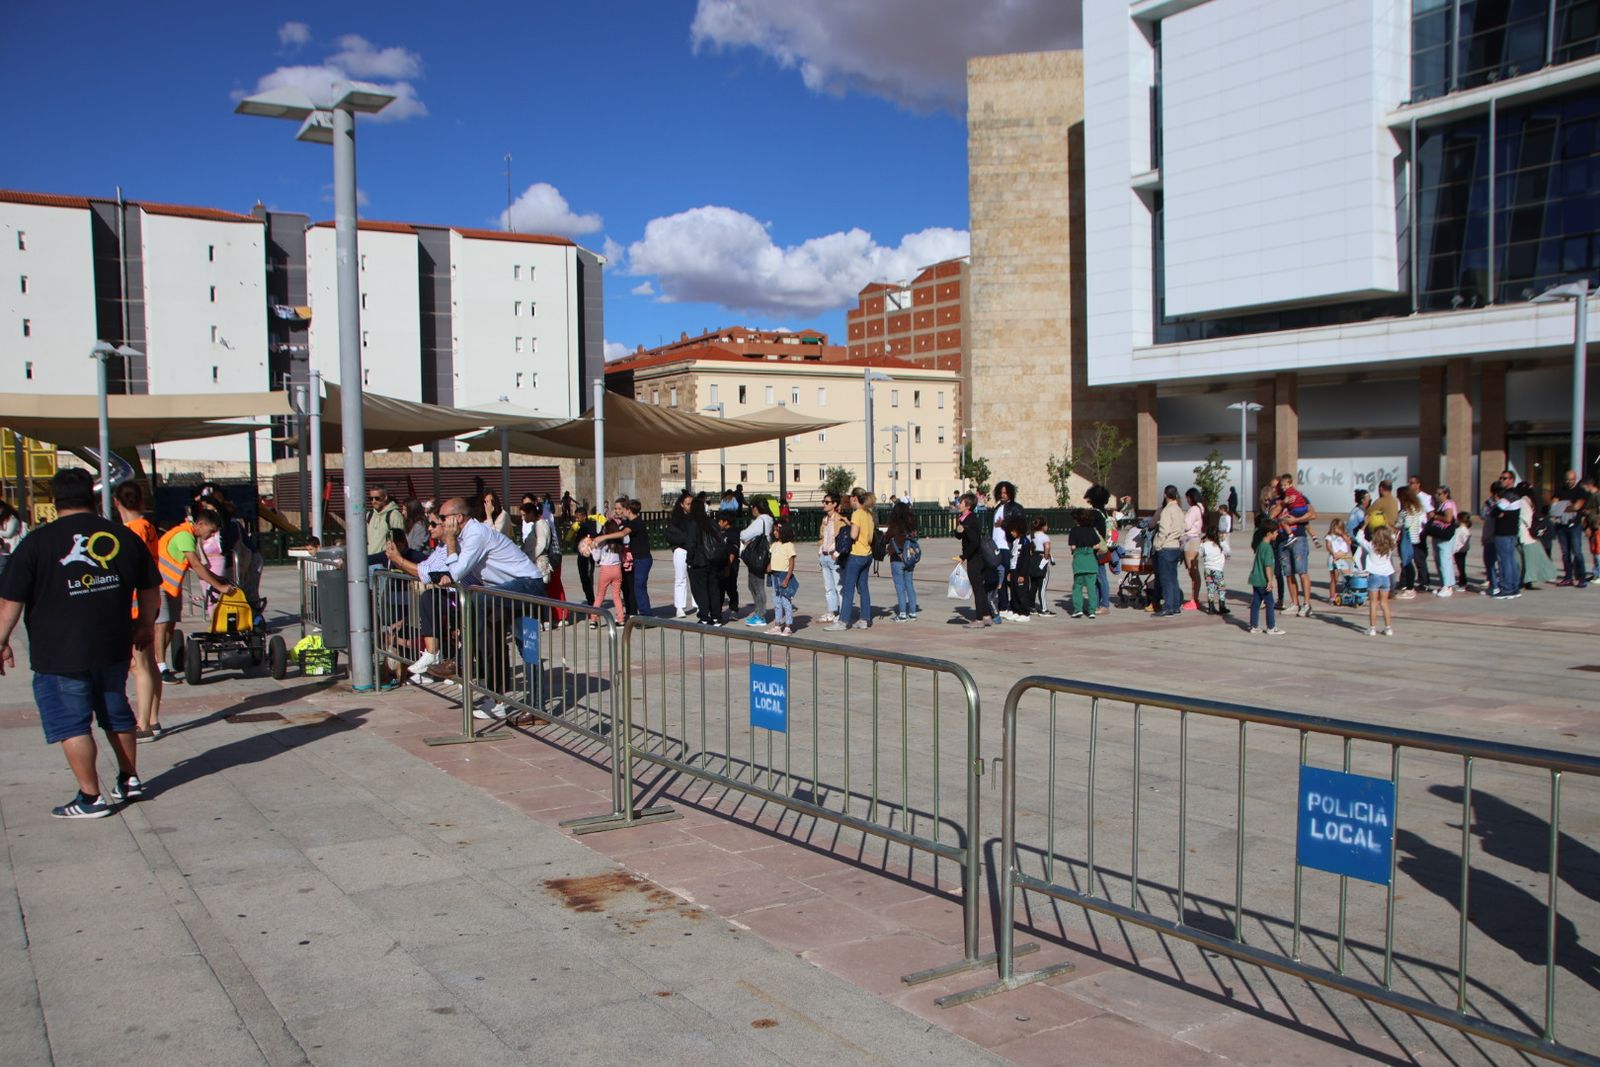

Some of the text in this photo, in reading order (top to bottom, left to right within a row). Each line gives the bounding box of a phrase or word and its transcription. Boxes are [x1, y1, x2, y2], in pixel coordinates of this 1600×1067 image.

[67, 579, 81, 589] La
[752, 680, 785, 697] POLICIA
[755, 697, 784, 714] LOCAL
[1308, 792, 1388, 827] POLICIA
[1311, 818, 1382, 853] LOCAL
